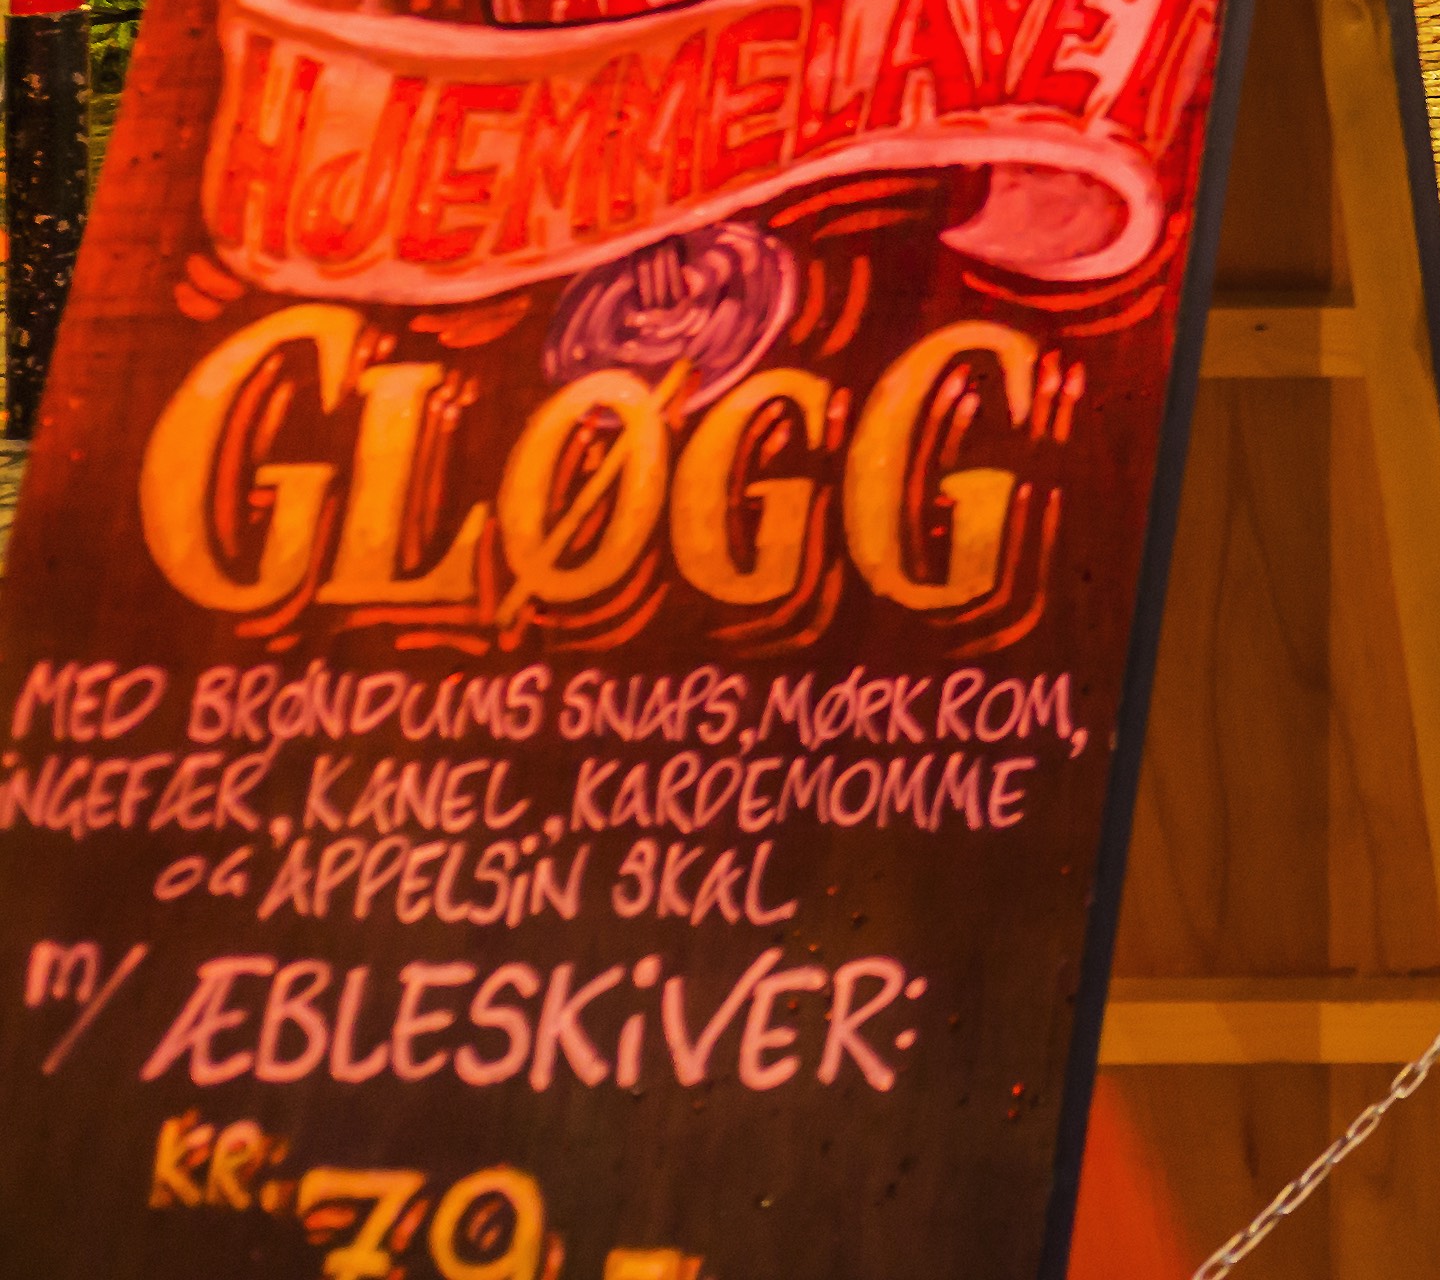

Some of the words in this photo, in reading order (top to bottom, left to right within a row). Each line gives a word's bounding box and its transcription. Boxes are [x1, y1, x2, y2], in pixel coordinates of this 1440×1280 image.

[138, 303, 1040, 628] GLØGG
[11, 659, 169, 741] MED
[187, 657, 553, 744] BRØNDUMS
[757, 664, 932, 750] MØRK
[570, 749, 1038, 834] KARDEMOMME
[612, 838, 799, 927] SKAL
